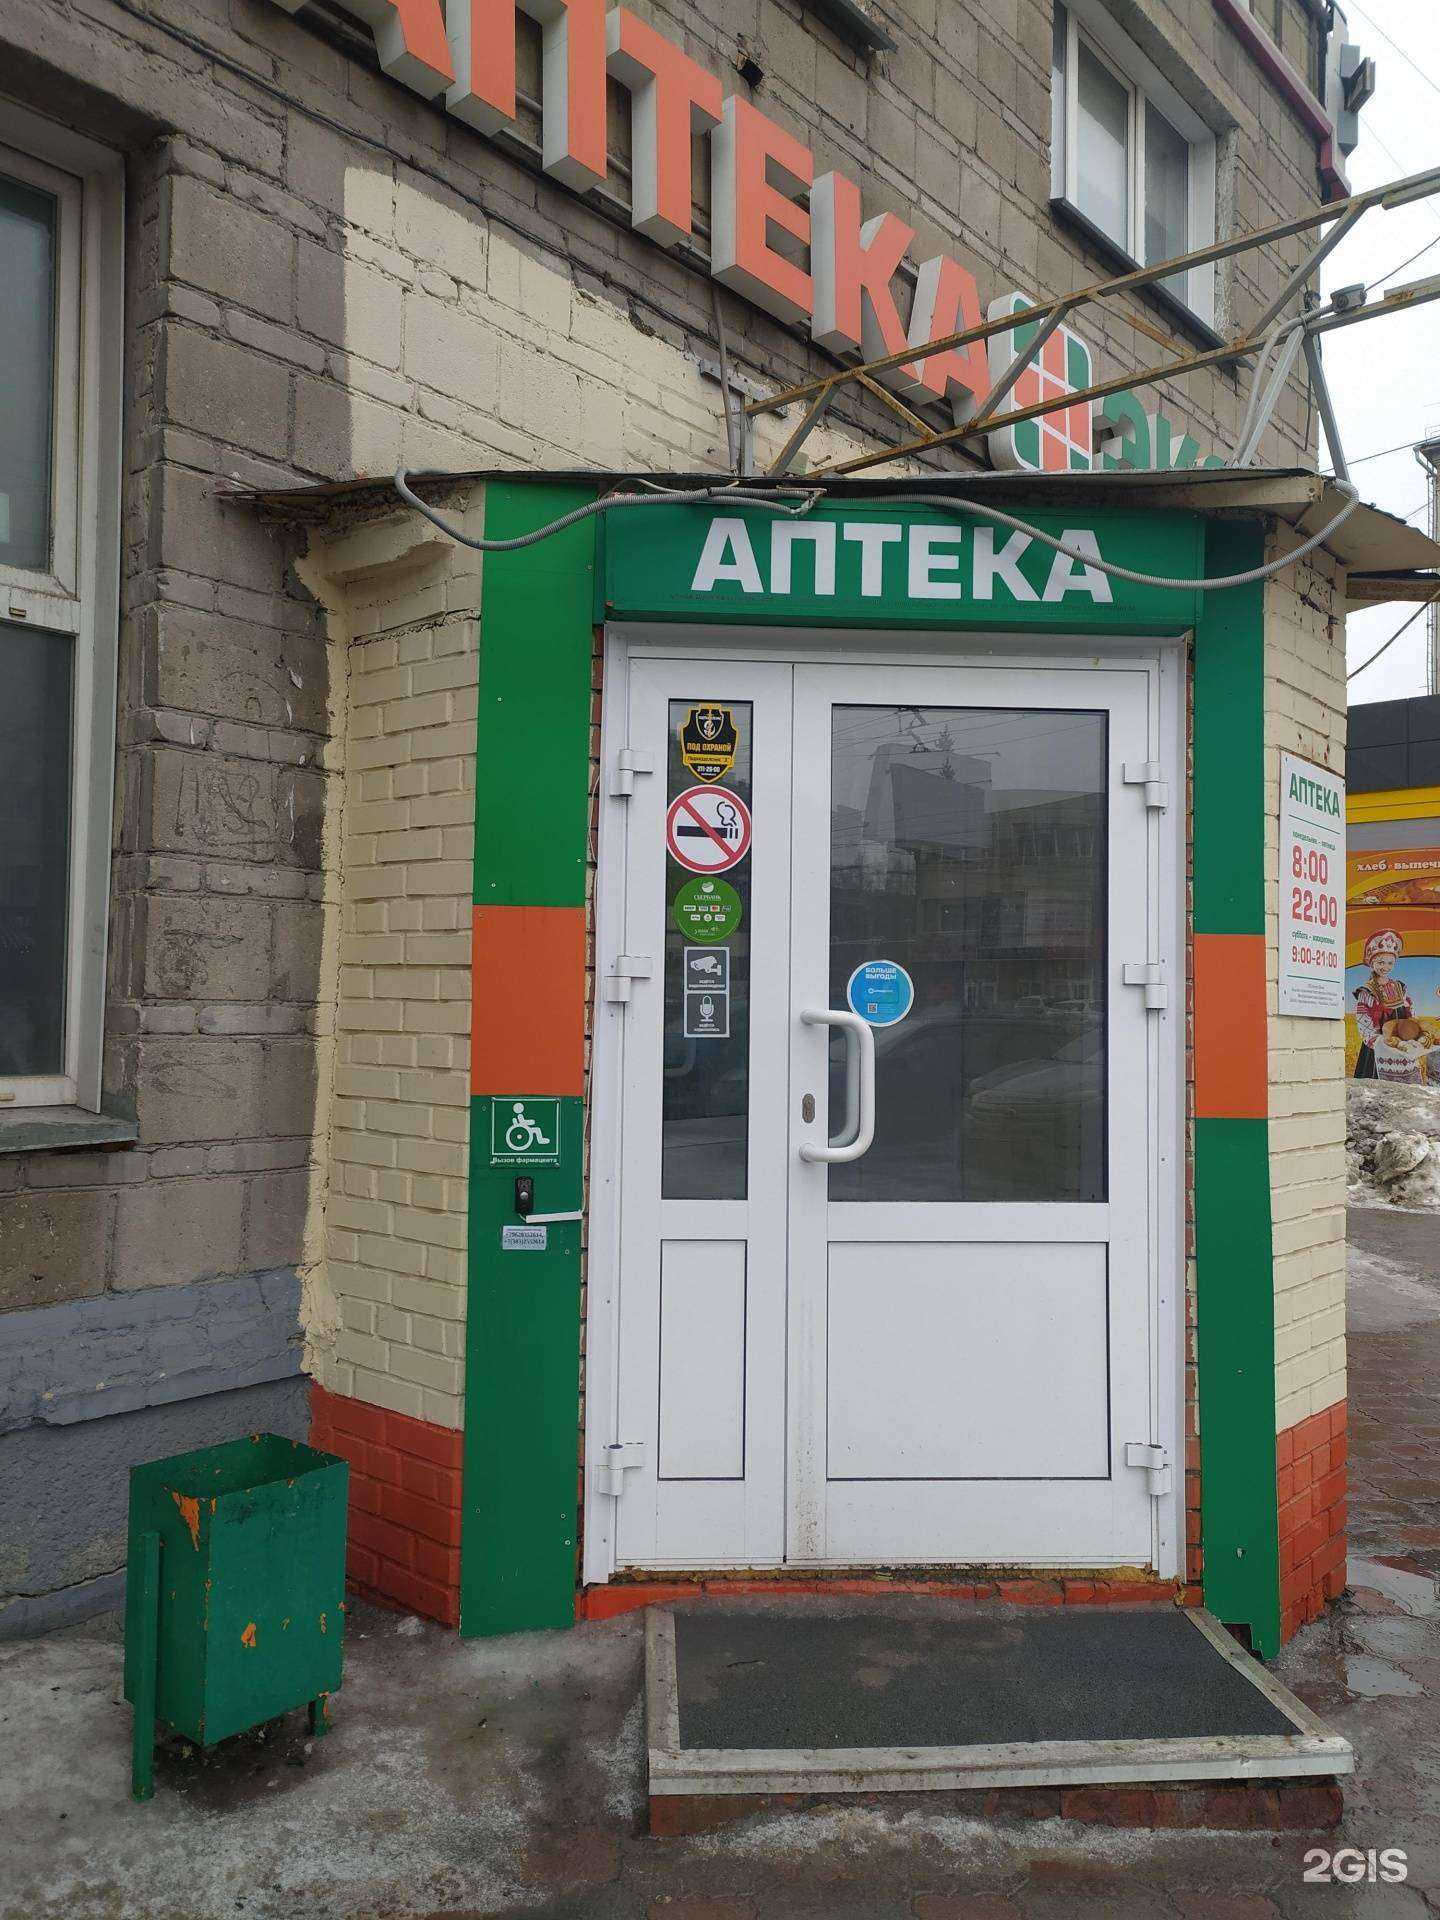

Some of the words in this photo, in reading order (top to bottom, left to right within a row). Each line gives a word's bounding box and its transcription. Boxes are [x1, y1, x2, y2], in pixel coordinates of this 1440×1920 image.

[373, 0, 1001, 428] ПТЕКА
[691, 517, 1113, 603] АПТЕКА
[687, 742, 701, 752] ПОД
[702, 743, 732, 752] ОХРАНОЙ
[1289, 772, 1341, 819] АПТЕКА
[1292, 845, 1328, 885] 8:00
[1357, 859, 1387, 872] хлеб
[1291, 886, 1338, 929] 22:00
